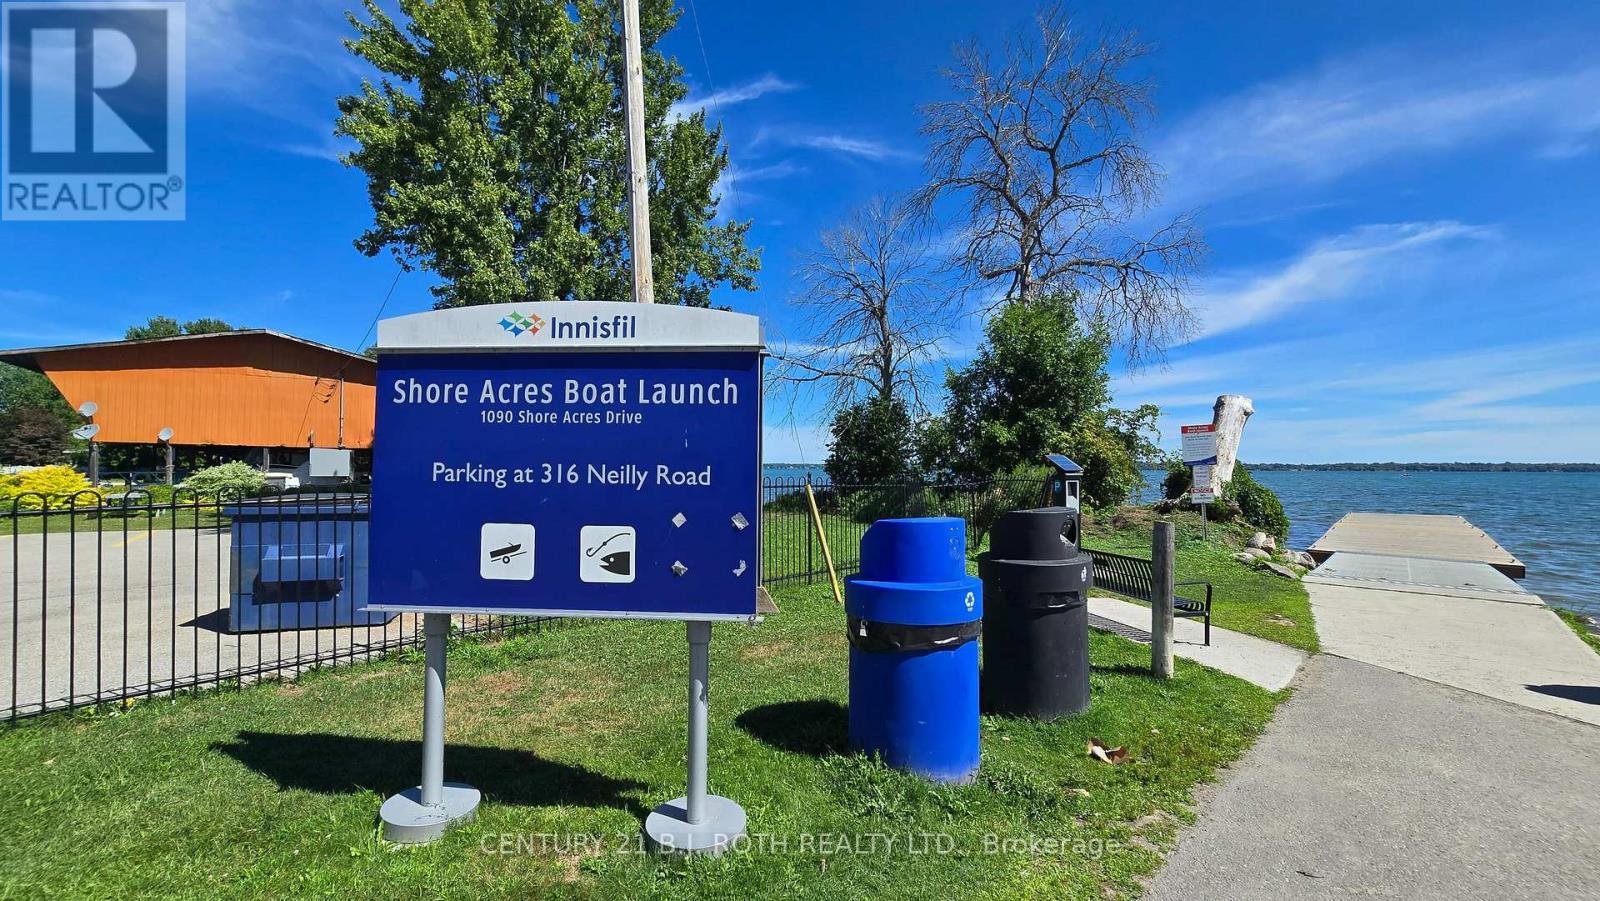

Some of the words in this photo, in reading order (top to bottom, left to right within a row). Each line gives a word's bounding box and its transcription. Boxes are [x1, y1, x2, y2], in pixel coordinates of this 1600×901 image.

[550, 315, 636, 339] Innisfil
[393, 378, 468, 404] Shore
[479, 379, 553, 404] Acres
[564, 378, 627, 404] Boat
[639, 377, 738, 405] Launch
[480, 410, 513, 423] 1090
[518, 409, 558, 424] Shore
[562, 410, 601, 424] Acres
[606, 410, 642, 424] Drive
[432, 462, 507, 489] Parking
[513, 467, 534, 483] at
[541, 463, 579, 484] 316
[587, 463, 648, 491] Neilly
[656, 464, 711, 486] Road
